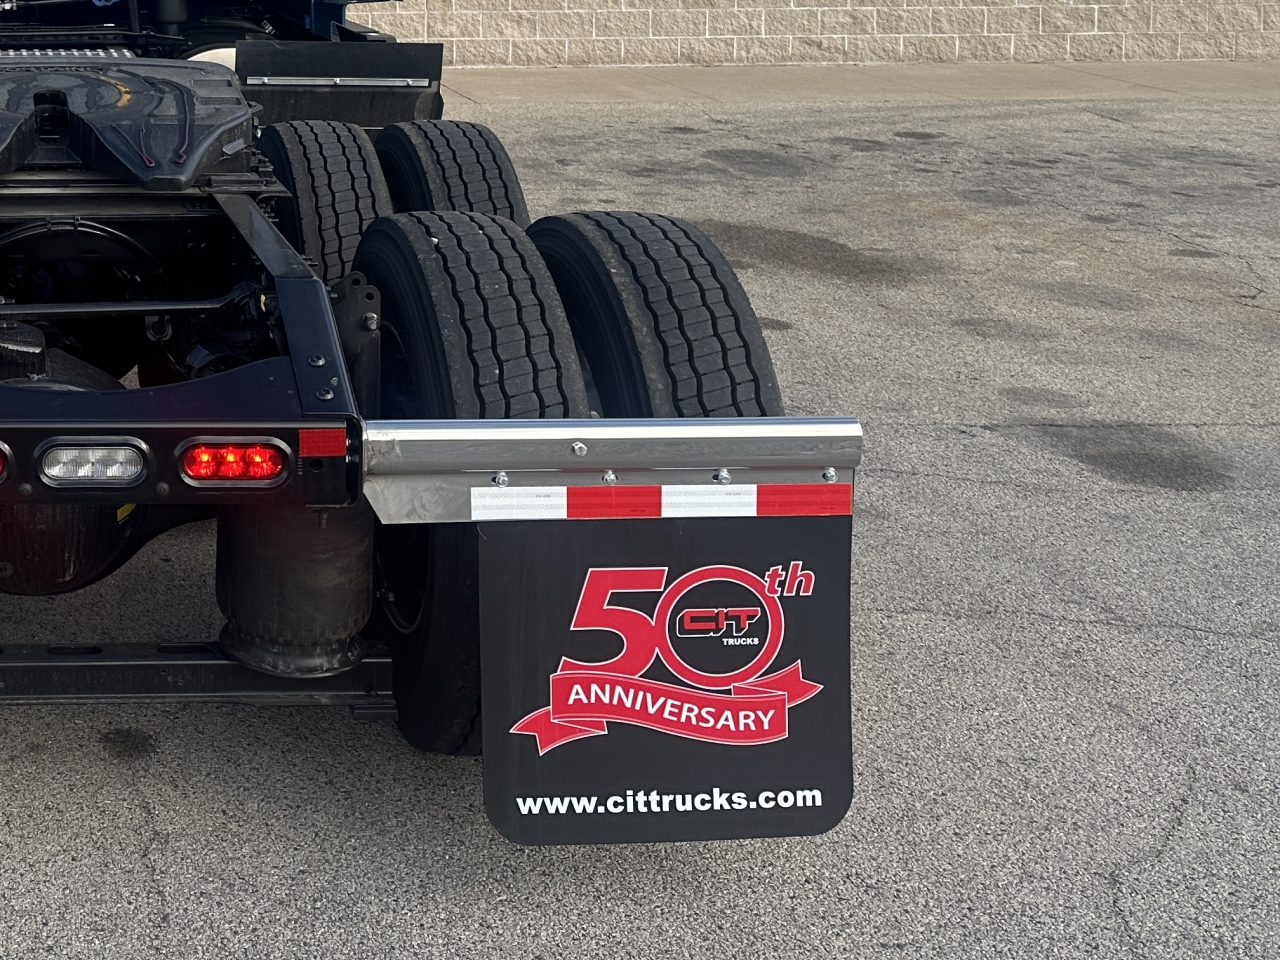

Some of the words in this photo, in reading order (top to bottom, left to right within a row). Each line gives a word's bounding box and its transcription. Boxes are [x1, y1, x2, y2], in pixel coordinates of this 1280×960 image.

[557, 561, 815, 690] 50th
[678, 607, 761, 635] CIT
[722, 637, 760, 646] TRUCKS
[567, 683, 775, 732] ANNIVERSARY
[516, 787, 823, 815] www.cittrucks.com
